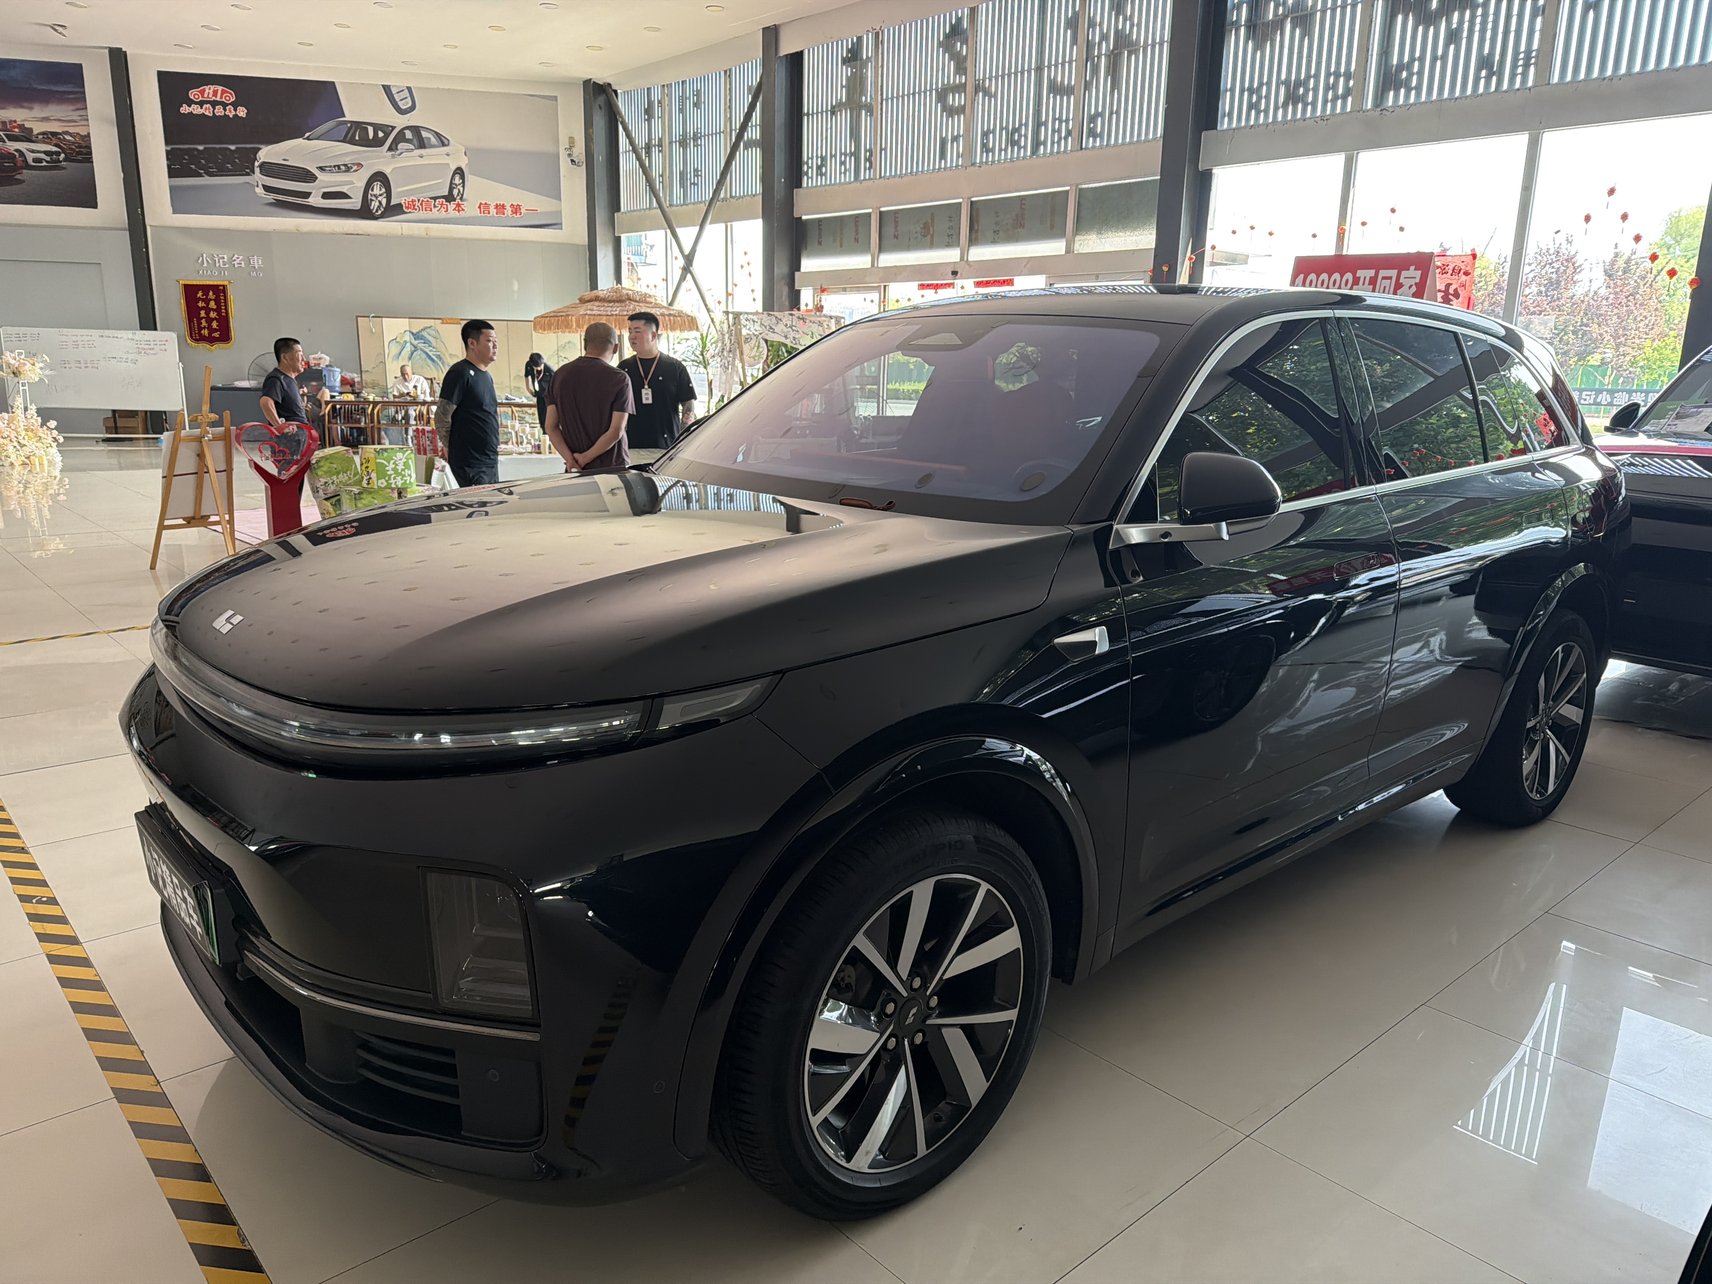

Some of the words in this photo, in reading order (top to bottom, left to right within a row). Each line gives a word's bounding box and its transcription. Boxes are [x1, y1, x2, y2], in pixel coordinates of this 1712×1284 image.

[403, 198, 466, 214] 诚信为本
[477, 201, 539, 216] 信誉第一
